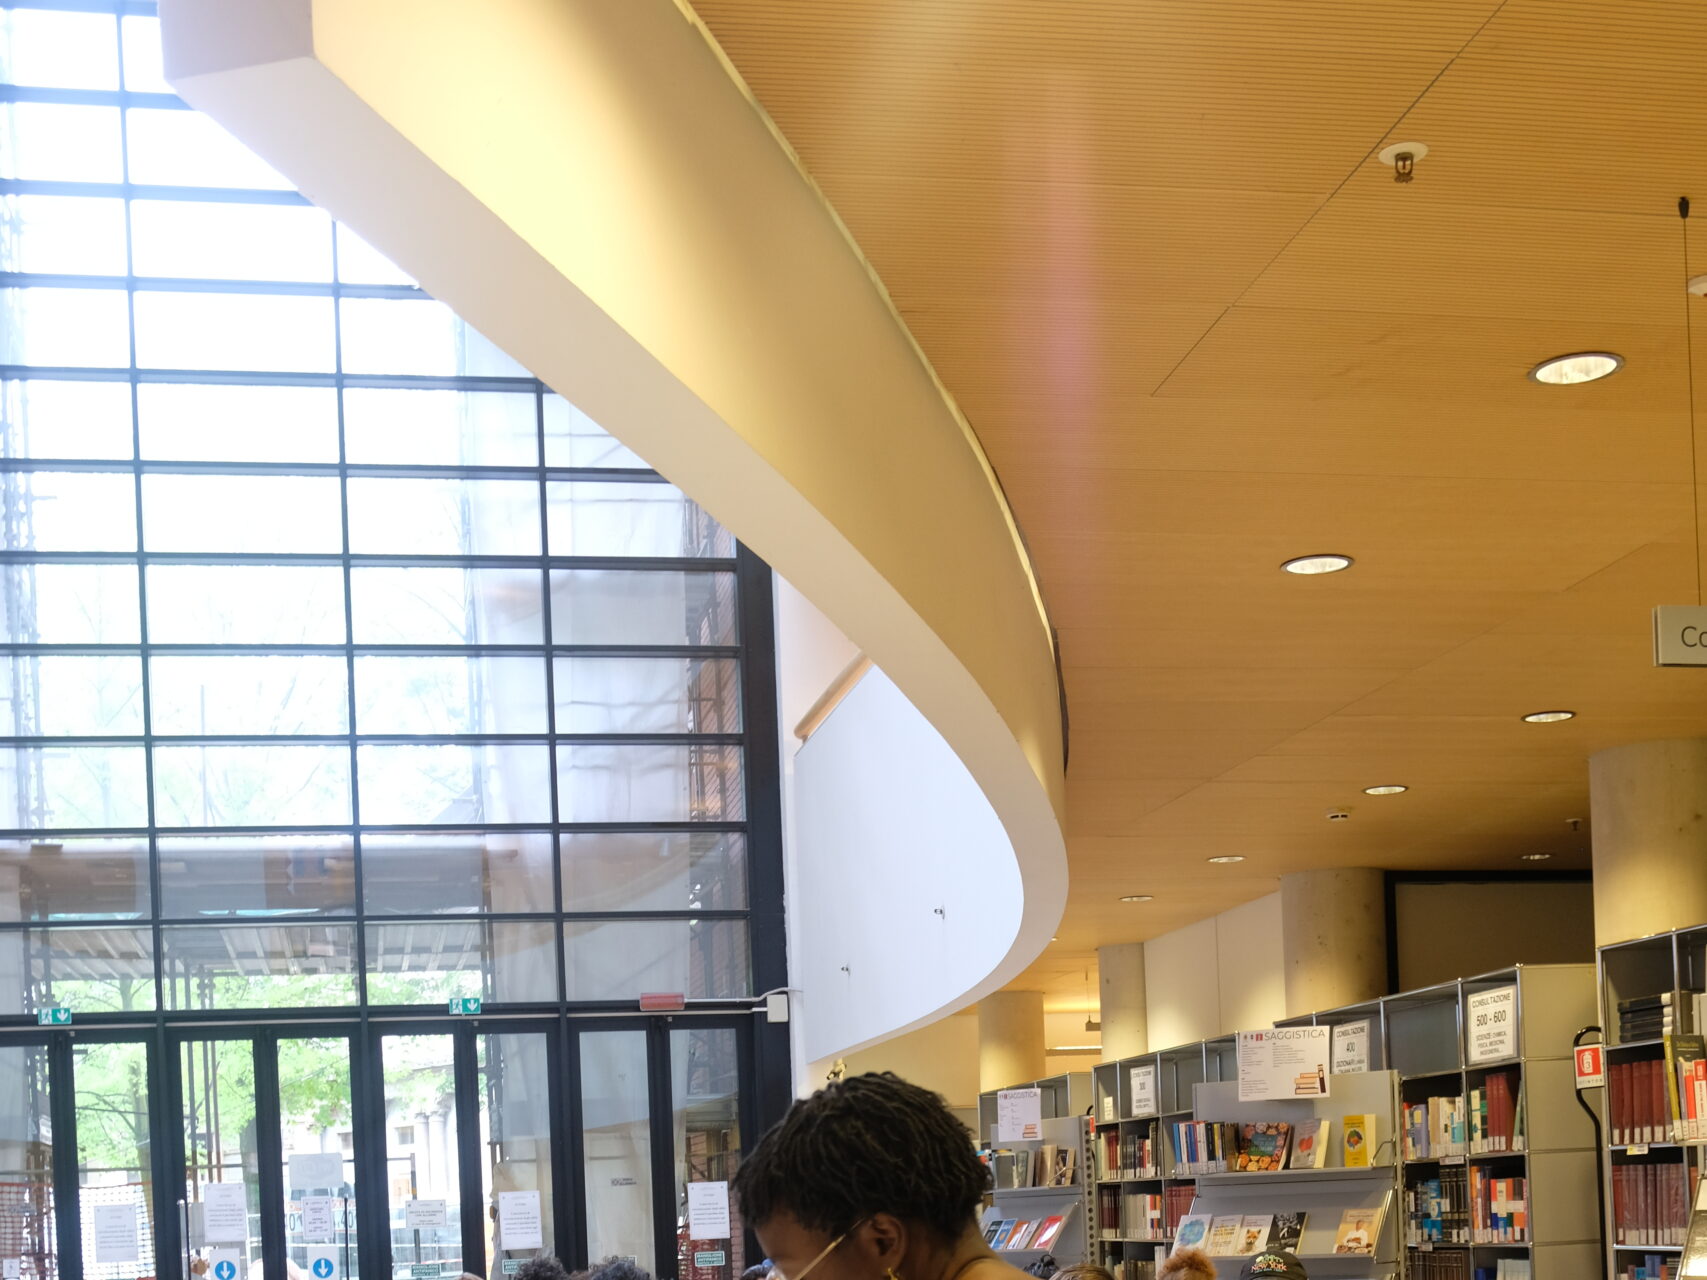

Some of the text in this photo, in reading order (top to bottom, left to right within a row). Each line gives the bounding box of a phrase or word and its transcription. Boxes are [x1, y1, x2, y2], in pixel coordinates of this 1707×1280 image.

[1476, 1013, 1488, 1027] 500
[1493, 1010, 1507, 1024] 600
[1264, 1029, 1325, 1041] SAGGISTICA
